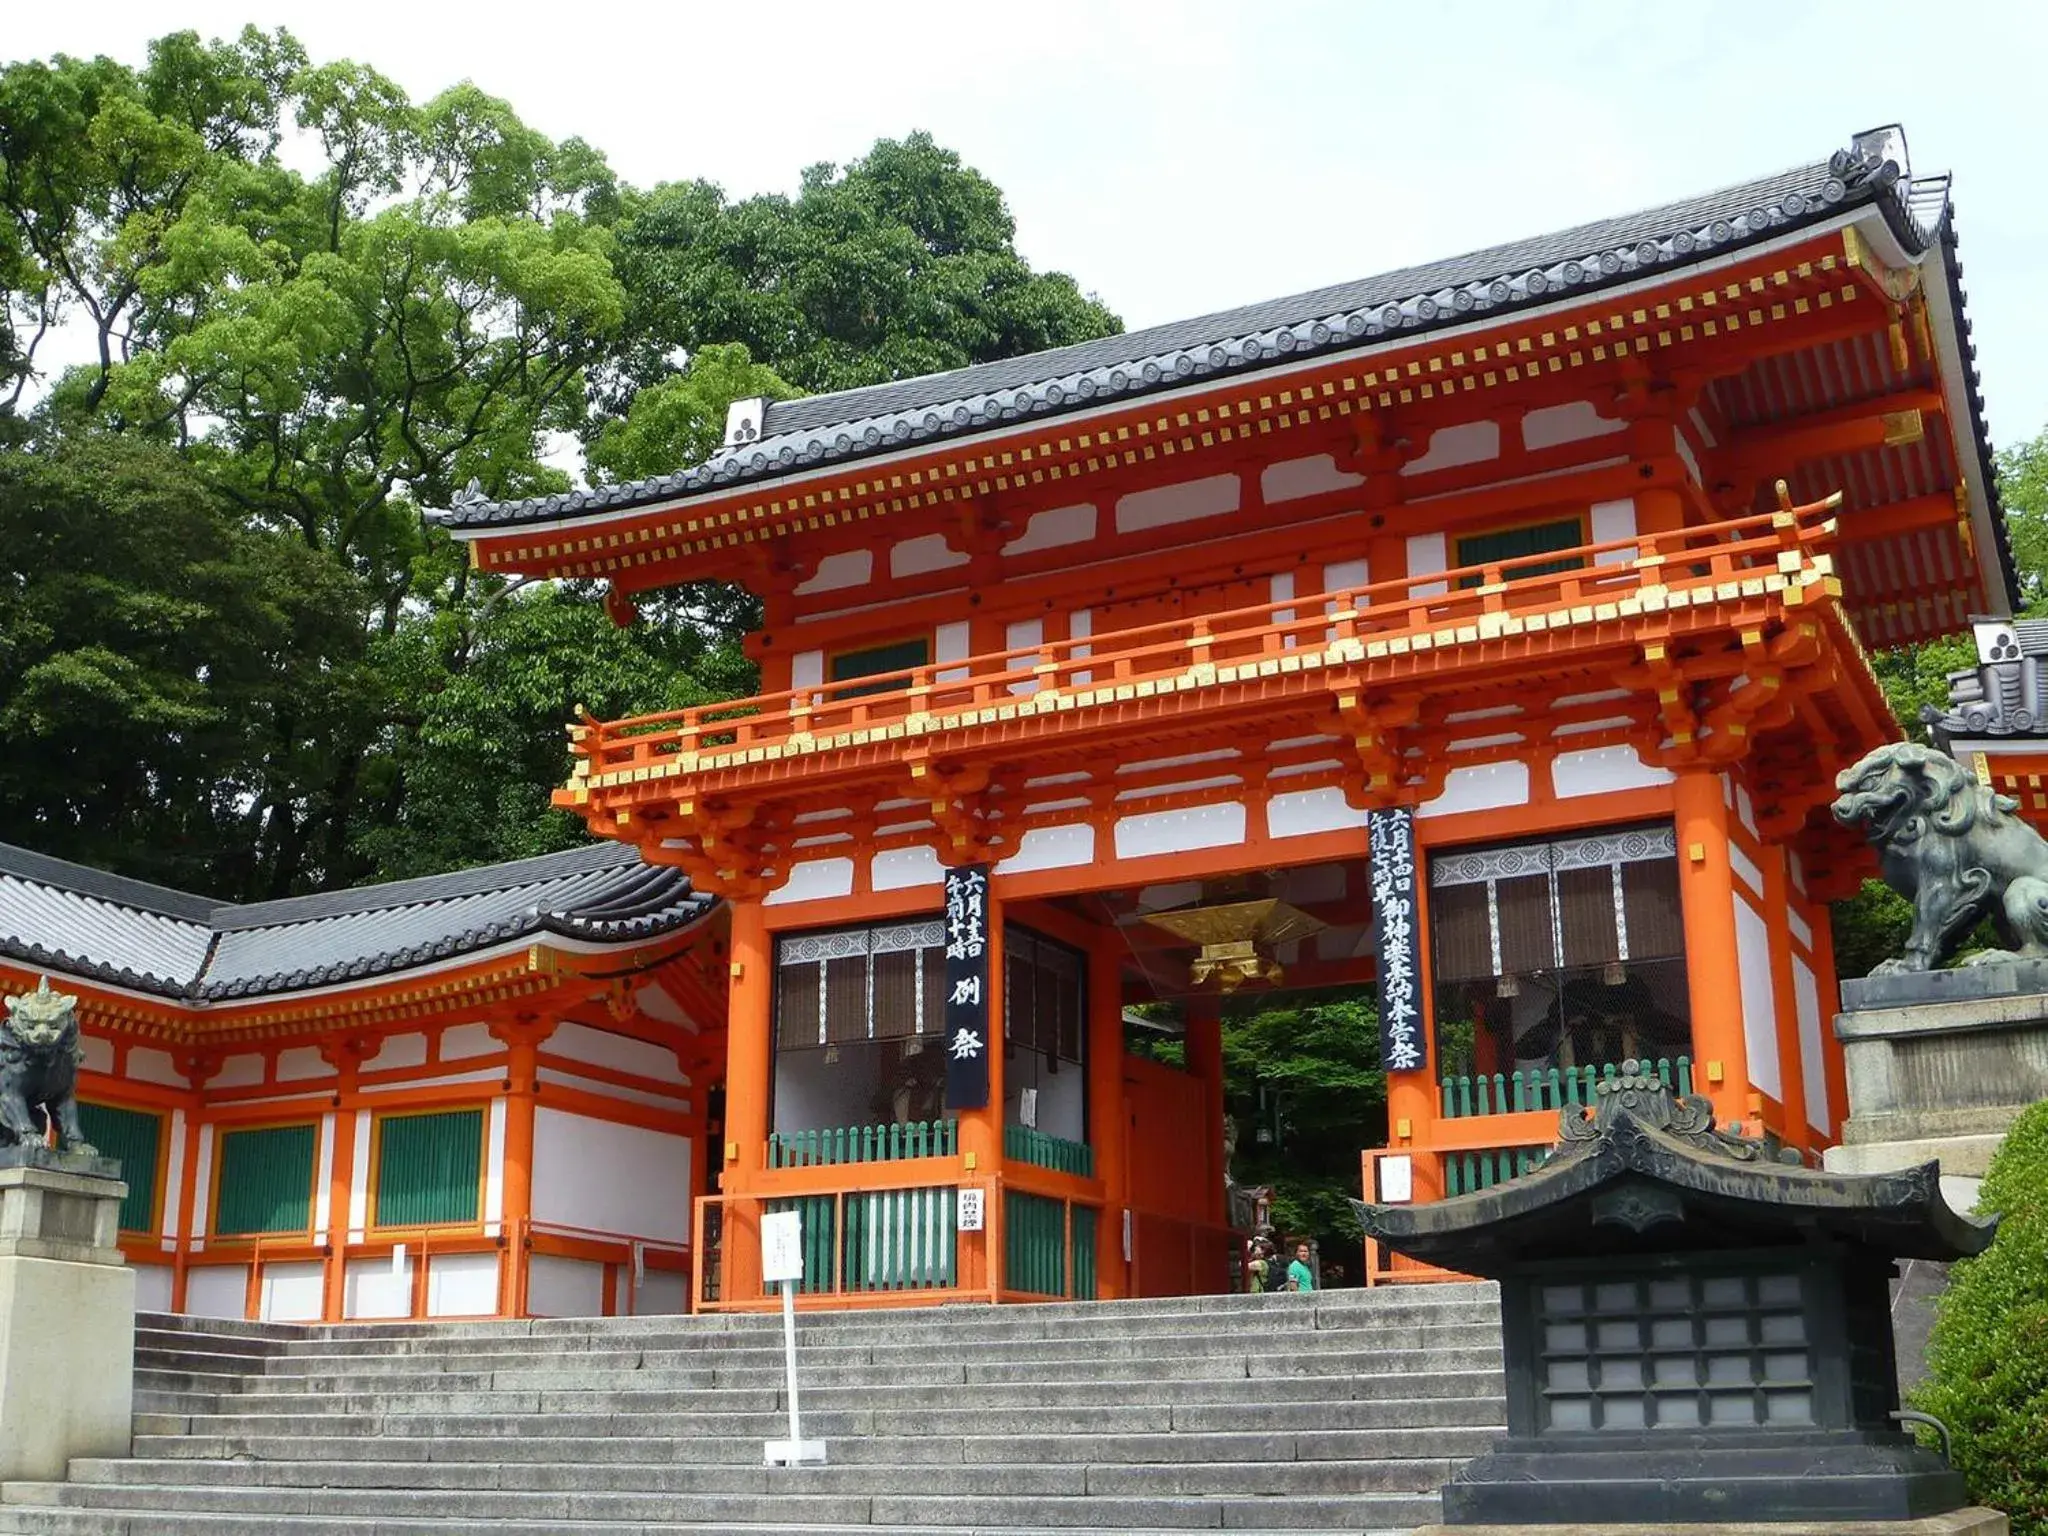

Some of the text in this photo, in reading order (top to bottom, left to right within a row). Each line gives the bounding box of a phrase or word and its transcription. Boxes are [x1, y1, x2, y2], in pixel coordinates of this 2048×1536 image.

[1389, 809, 1413, 891] 六月十四日
[946, 875, 965, 960] 午前十時
